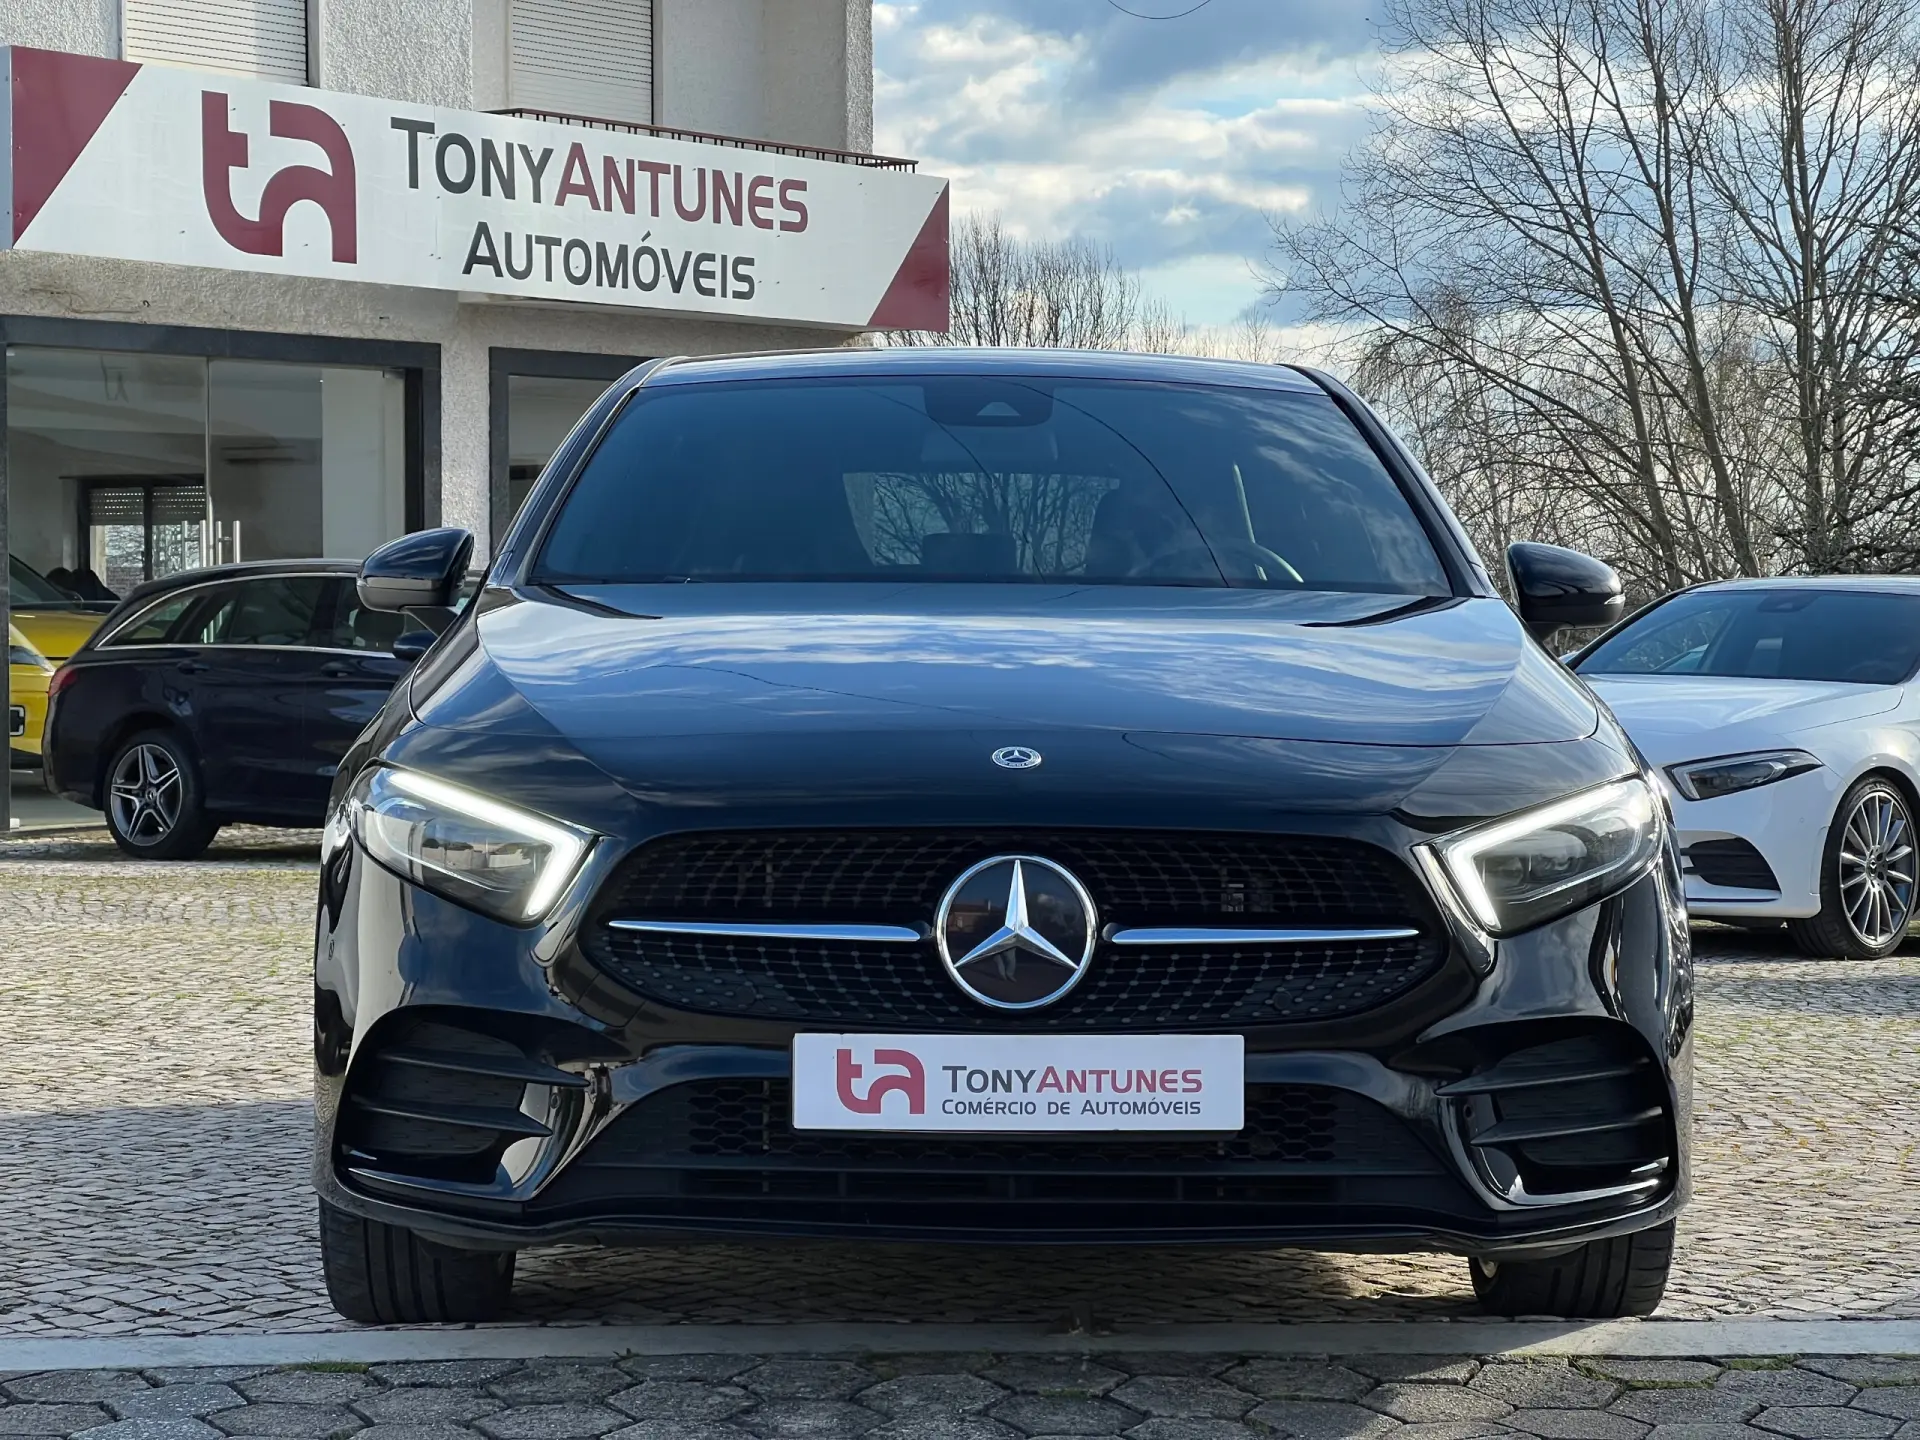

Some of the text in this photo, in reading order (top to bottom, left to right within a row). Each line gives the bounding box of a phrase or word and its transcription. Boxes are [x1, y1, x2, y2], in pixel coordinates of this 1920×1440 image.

[461, 221, 756, 301] AUTOMÓVEIS
[941, 1097, 1201, 1116] COMÉRCIO DE AUTOMÓVEIS
